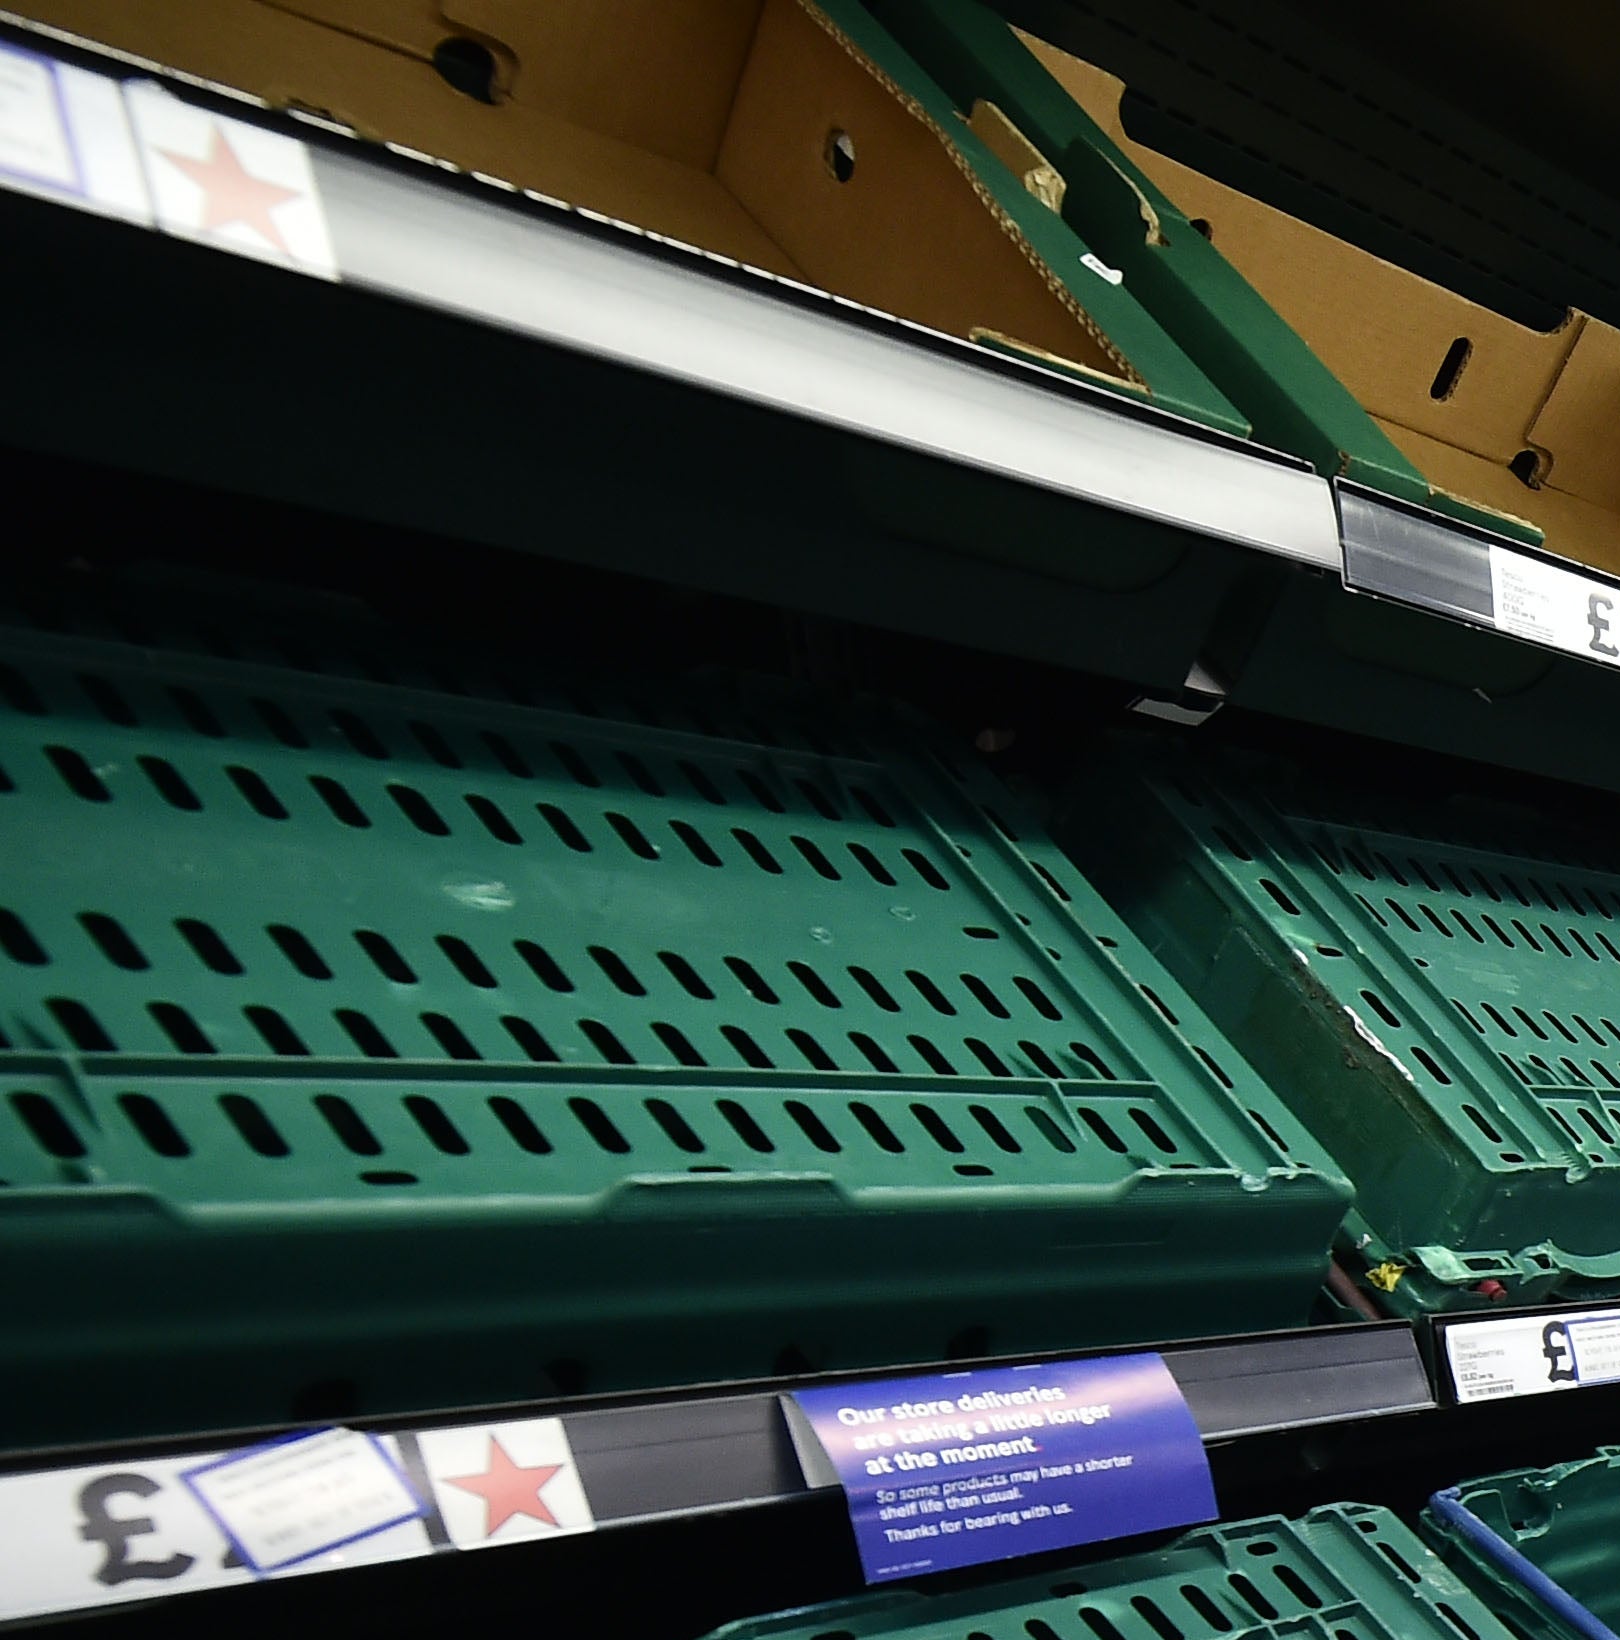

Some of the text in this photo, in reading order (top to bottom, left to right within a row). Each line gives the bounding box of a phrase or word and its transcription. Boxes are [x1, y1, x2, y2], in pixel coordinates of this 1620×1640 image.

[1541, 1320, 1577, 1384] £
[837, 1386, 1067, 1427] Our store deliveries
[853, 1403, 1112, 1451] are taking a little longer
[864, 1456, 894, 1476] at
[894, 1449, 938, 1472] the
[876, 1455, 1134, 1505] So some products may have a shorter
[878, 1502, 919, 1521] shelf
[919, 1498, 945, 1515] life
[945, 1492, 981, 1511] than
[883, 1523, 940, 1544] Thanks
[939, 1518, 963, 1535] for
[964, 1510, 1021, 1531] bearing
[1020, 1504, 1052, 1522] with
